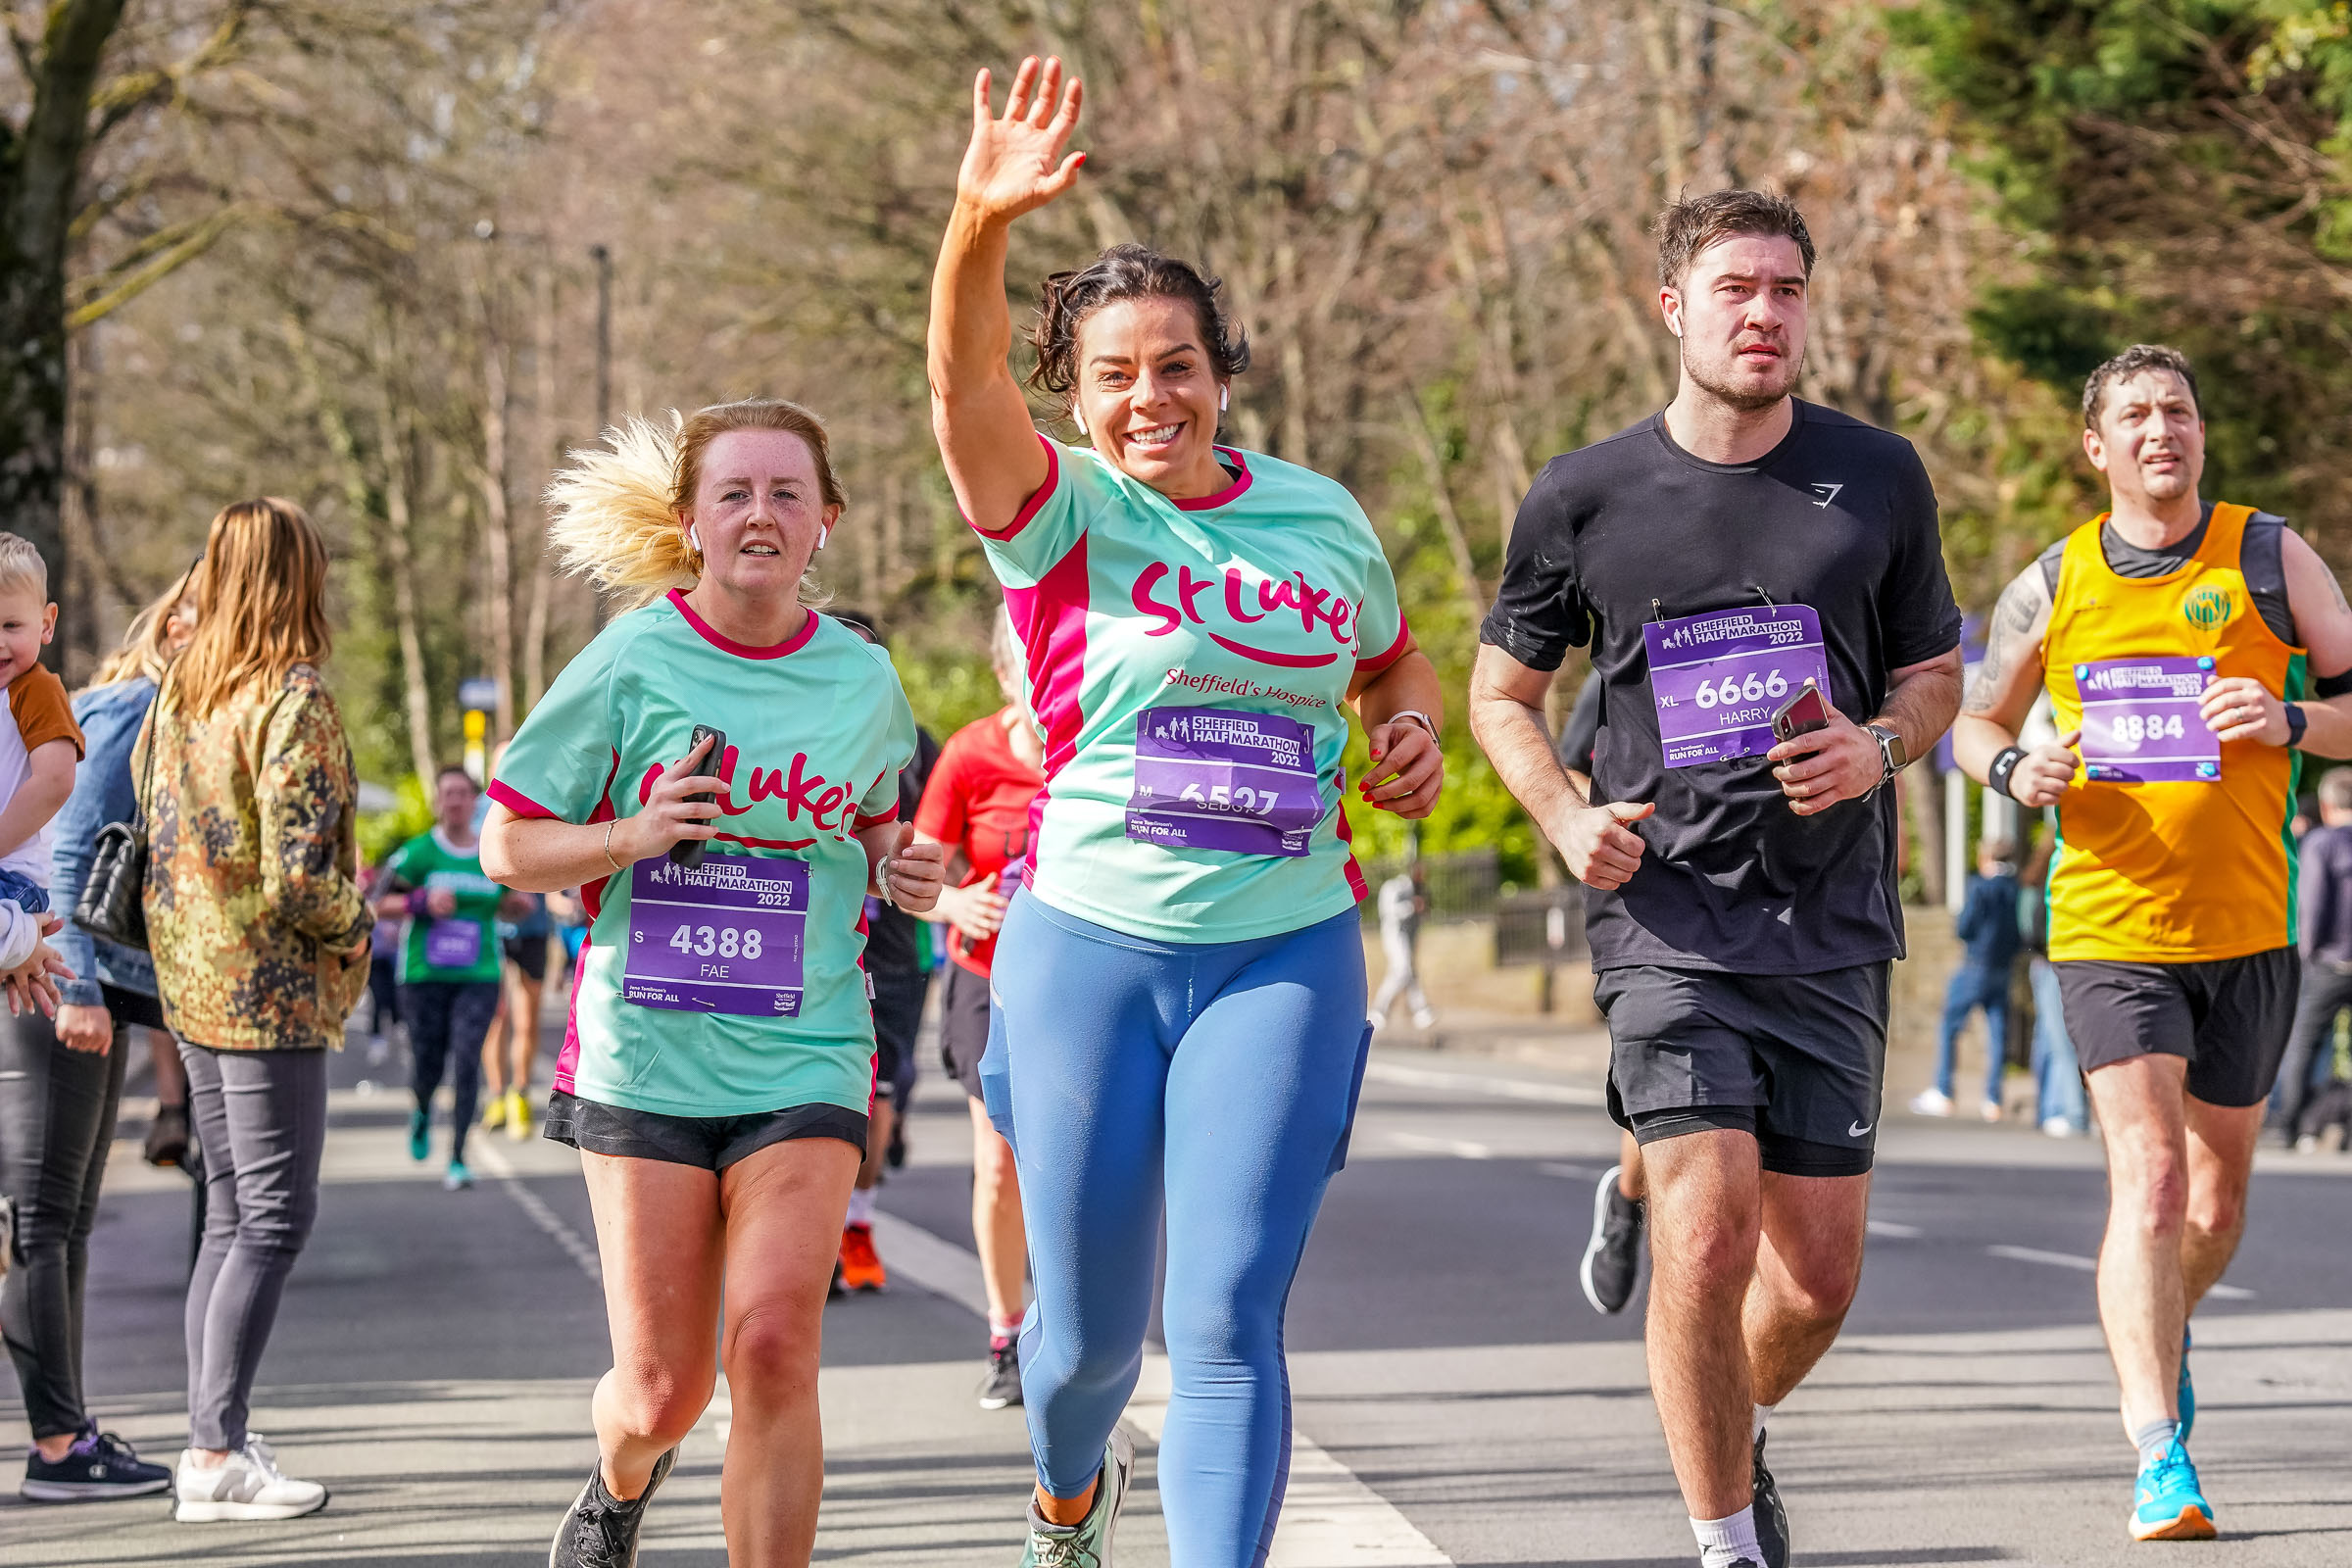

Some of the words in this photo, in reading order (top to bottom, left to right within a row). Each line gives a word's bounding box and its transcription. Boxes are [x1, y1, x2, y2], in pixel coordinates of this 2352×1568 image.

[1131, 561, 1215, 637] St
[1693, 615, 1751, 633] SHEFFIELD
[1695, 629, 1726, 644] HALF
[1729, 620, 1801, 639] MARATHON
[1769, 631, 1804, 646] 2022
[1165, 668, 1261, 697] Sheffield's
[1263, 686, 1327, 709] Hospice
[1659, 694, 1680, 710] XL
[1695, 668, 1788, 710] 6666
[1194, 717, 1256, 733] SHEFFIELD
[1719, 707, 1771, 726] HARRY
[2111, 713, 2185, 743] 8884
[1193, 730, 1229, 743] HALF
[1231, 733, 1298, 754] MARATHON
[1271, 751, 1301, 767] 2022
[1669, 751, 1687, 761] RUN
[1687, 749, 1703, 759] FOR
[1704, 746, 1720, 756] ALL
[1139, 784, 1153, 797] M
[1151, 826, 1169, 836] FOR
[1170, 828, 1188, 838] ALL
[685, 864, 745, 877] EFFIELD
[685, 874, 717, 887] HALF
[717, 876, 791, 893] MARATHON
[757, 893, 791, 906] 2022
[634, 931, 644, 944] S
[669, 924, 762, 960] 4388
[700, 964, 730, 979] FAE
[628, 991, 646, 1000] RUN
[647, 992, 663, 1001] FOR
[664, 994, 680, 1003] ALL
